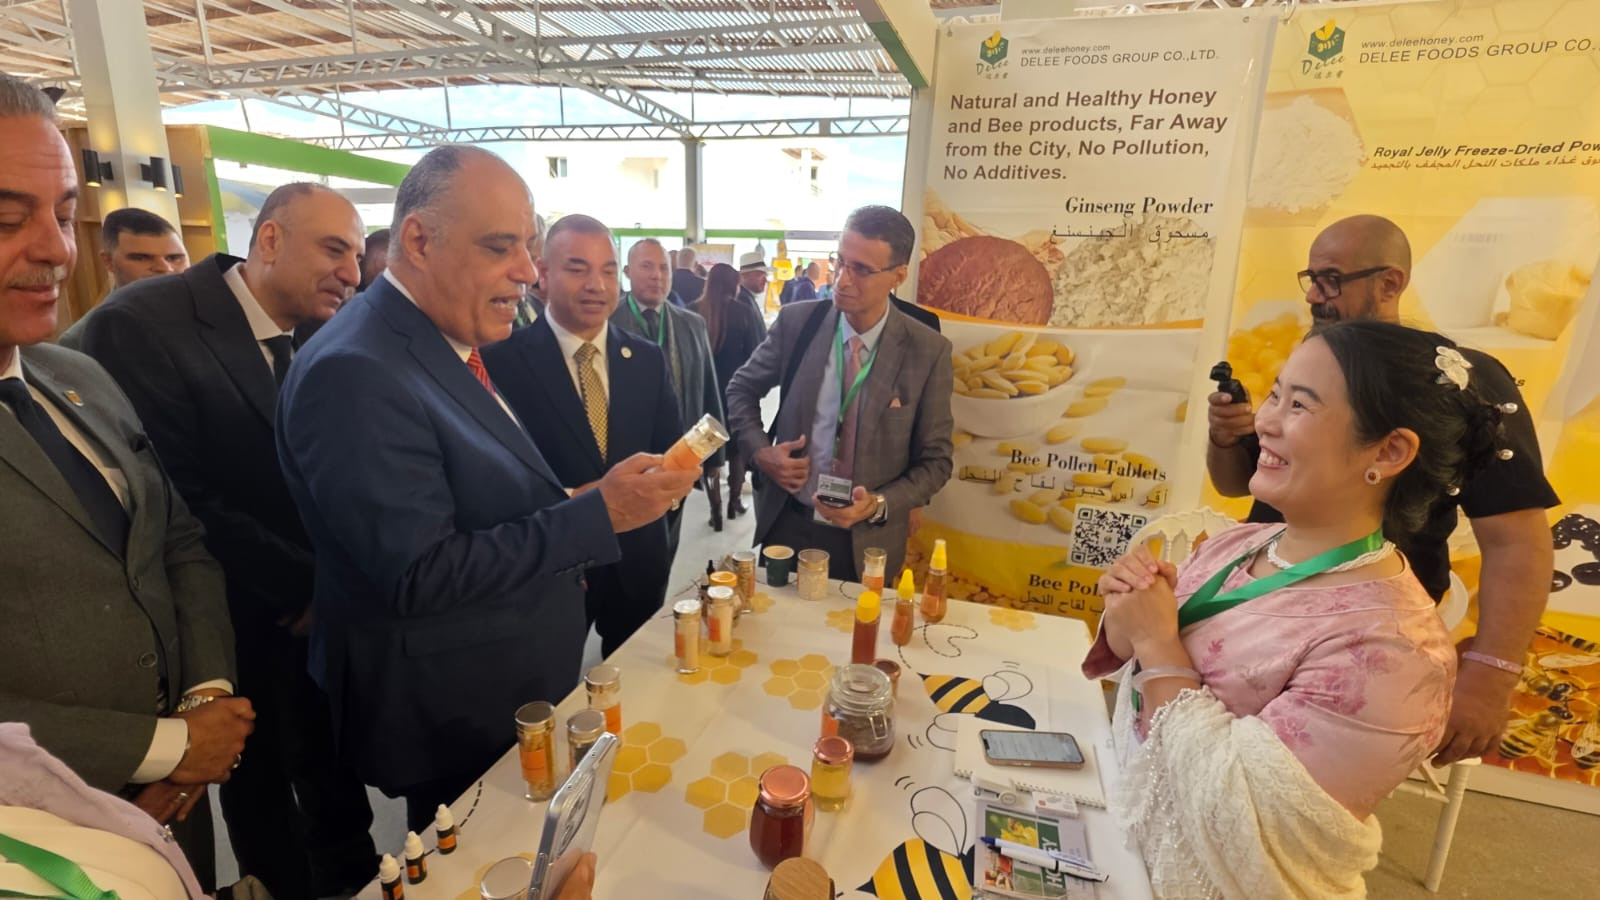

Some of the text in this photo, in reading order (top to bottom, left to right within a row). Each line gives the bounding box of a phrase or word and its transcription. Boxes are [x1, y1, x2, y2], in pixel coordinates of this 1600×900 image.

[1021, 44, 1111, 55] www.deleehoney.com
[1361, 34, 1484, 48] www.deleehoney.com
[1020, 56, 1060, 67] DELEE
[1063, 53, 1108, 66] FOODS
[1112, 51, 1160, 64] GROUP
[1359, 50, 1412, 64] DELEE
[1416, 46, 1480, 61] FOODS
[1486, 40, 1559, 57] GROUP
[950, 88, 1217, 111] Natural and Healthy Honey
[947, 113, 1229, 136] and Bee products, Far Away
[945, 139, 1210, 160] from the City, No Pollution,
[1373, 146, 1414, 160] Royal
[1415, 145, 1452, 159] Jelly
[1454, 141, 1566, 157] Freeze-Dried
[943, 164, 1068, 180] No Additives.
[1065, 196, 1214, 218] Ginseng Powder
[1149, 224, 1209, 244] مسحوق
[1011, 448, 1167, 481] Bee Pollen Tablets
[1029, 573, 1104, 598] Bee Pol
